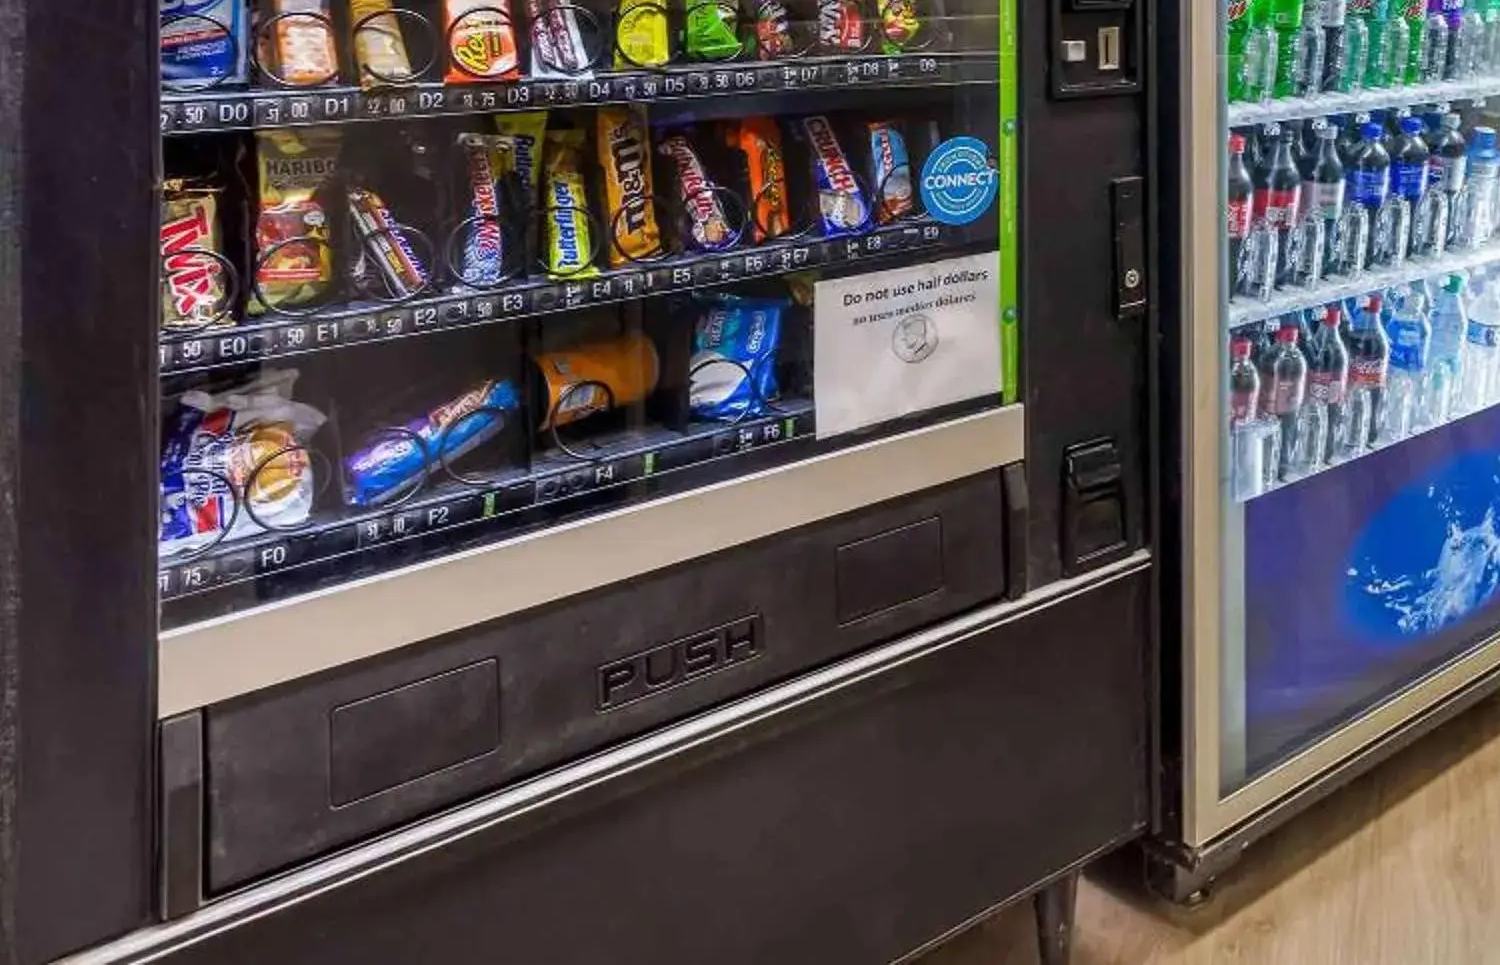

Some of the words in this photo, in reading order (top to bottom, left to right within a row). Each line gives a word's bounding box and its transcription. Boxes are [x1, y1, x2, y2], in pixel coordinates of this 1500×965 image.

[735, 71, 755, 86] D6
[801, 66, 818, 81] D7
[589, 83, 611, 98] D4
[665, 78, 686, 93] D5
[419, 92, 444, 109] D2
[507, 87, 530, 104] D3
[219, 104, 248, 122] D0
[325, 98, 349, 115] D1
[806, 118, 857, 192] CRUNCH
[923, 169, 995, 191] CONNECT
[673, 267, 692, 284] E5
[842, 293, 862, 308] Do
[865, 287, 889, 303] not
[893, 284, 915, 299] use
[917, 275, 943, 294] half
[943, 269, 989, 286] dollars
[503, 293, 524, 311] E3
[414, 308, 438, 326] E2
[316, 323, 340, 342] E1
[219, 336, 246, 358] E0
[762, 424, 781, 440] F6
[595, 465, 613, 482] F4
[428, 506, 449, 526] F2
[261, 546, 286, 568] F0
[600, 615, 764, 710] PUSH
